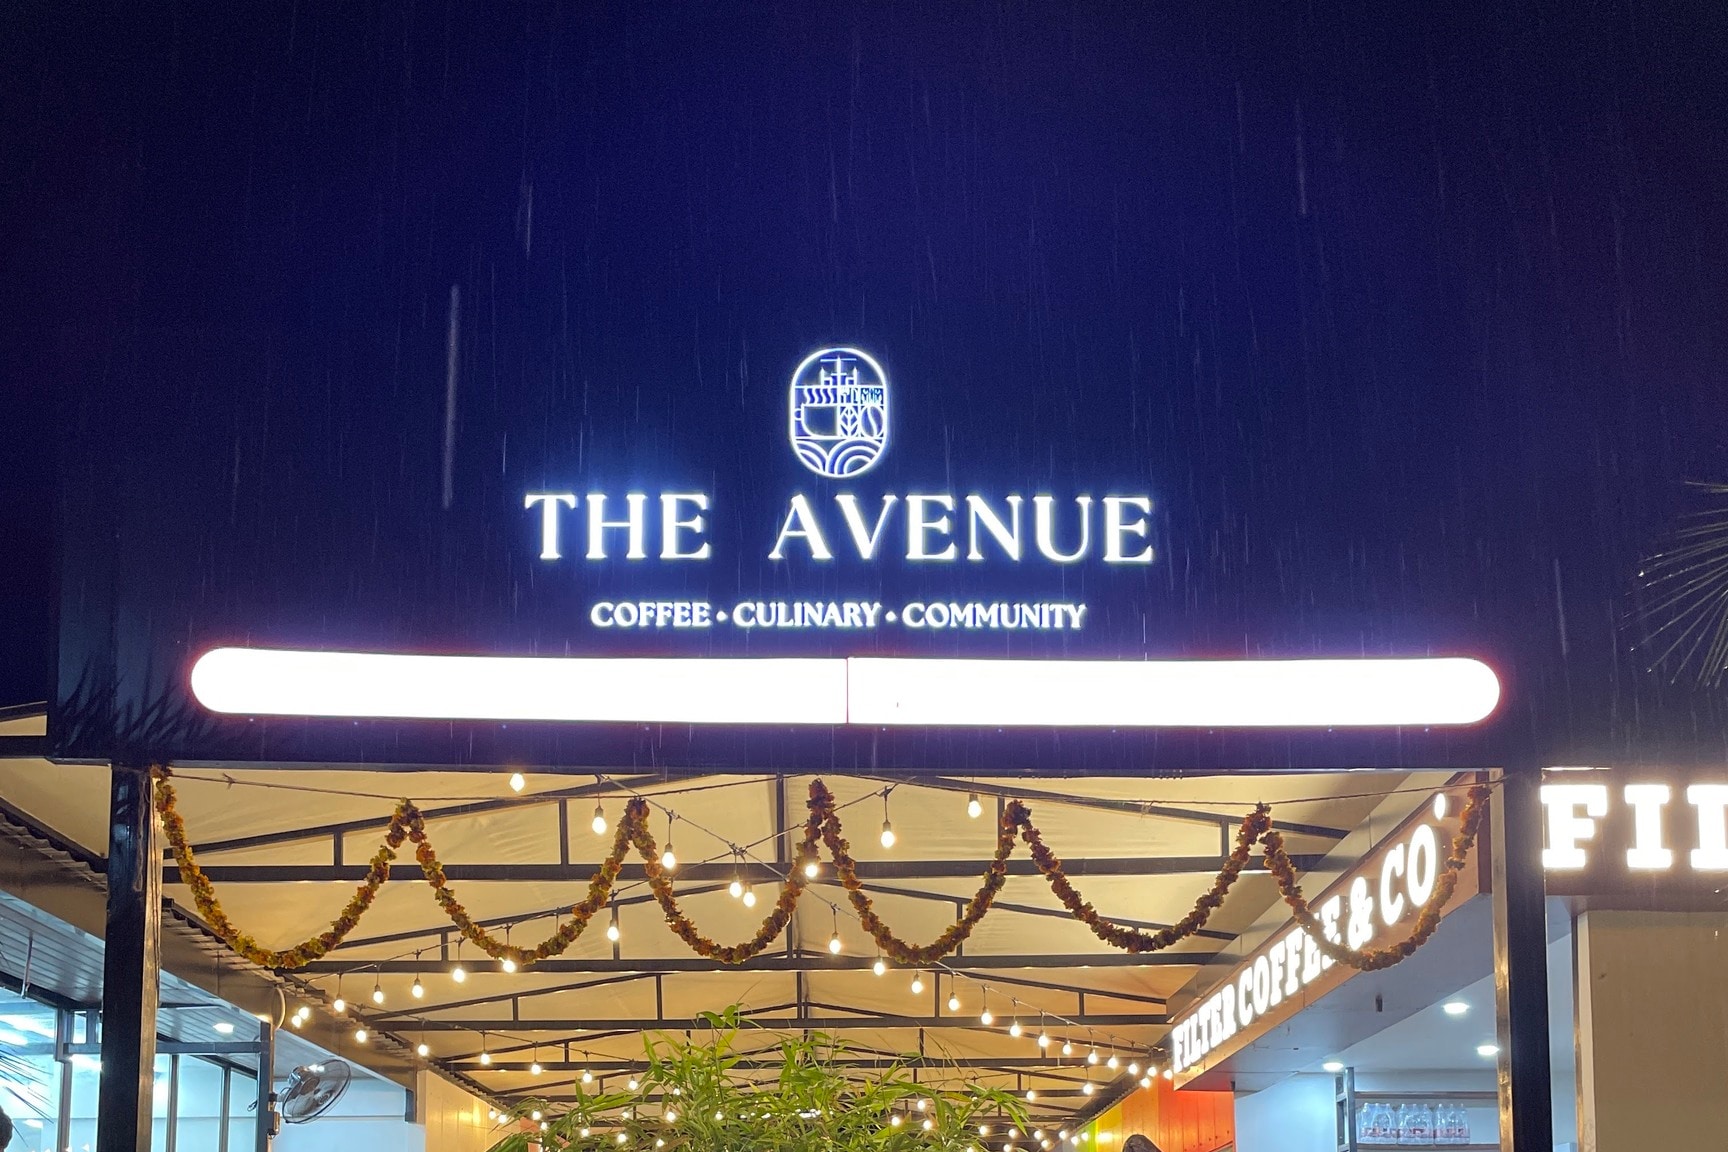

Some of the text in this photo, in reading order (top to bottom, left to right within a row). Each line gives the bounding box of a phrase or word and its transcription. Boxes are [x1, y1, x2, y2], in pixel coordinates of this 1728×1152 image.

[524, 493, 1153, 562] THE AVENUE
[590, 601, 1087, 629] COFFEE CULINARY COMMUNITY
[1172, 983, 1237, 1074] FILTER
[1347, 876, 1374, 951] &
